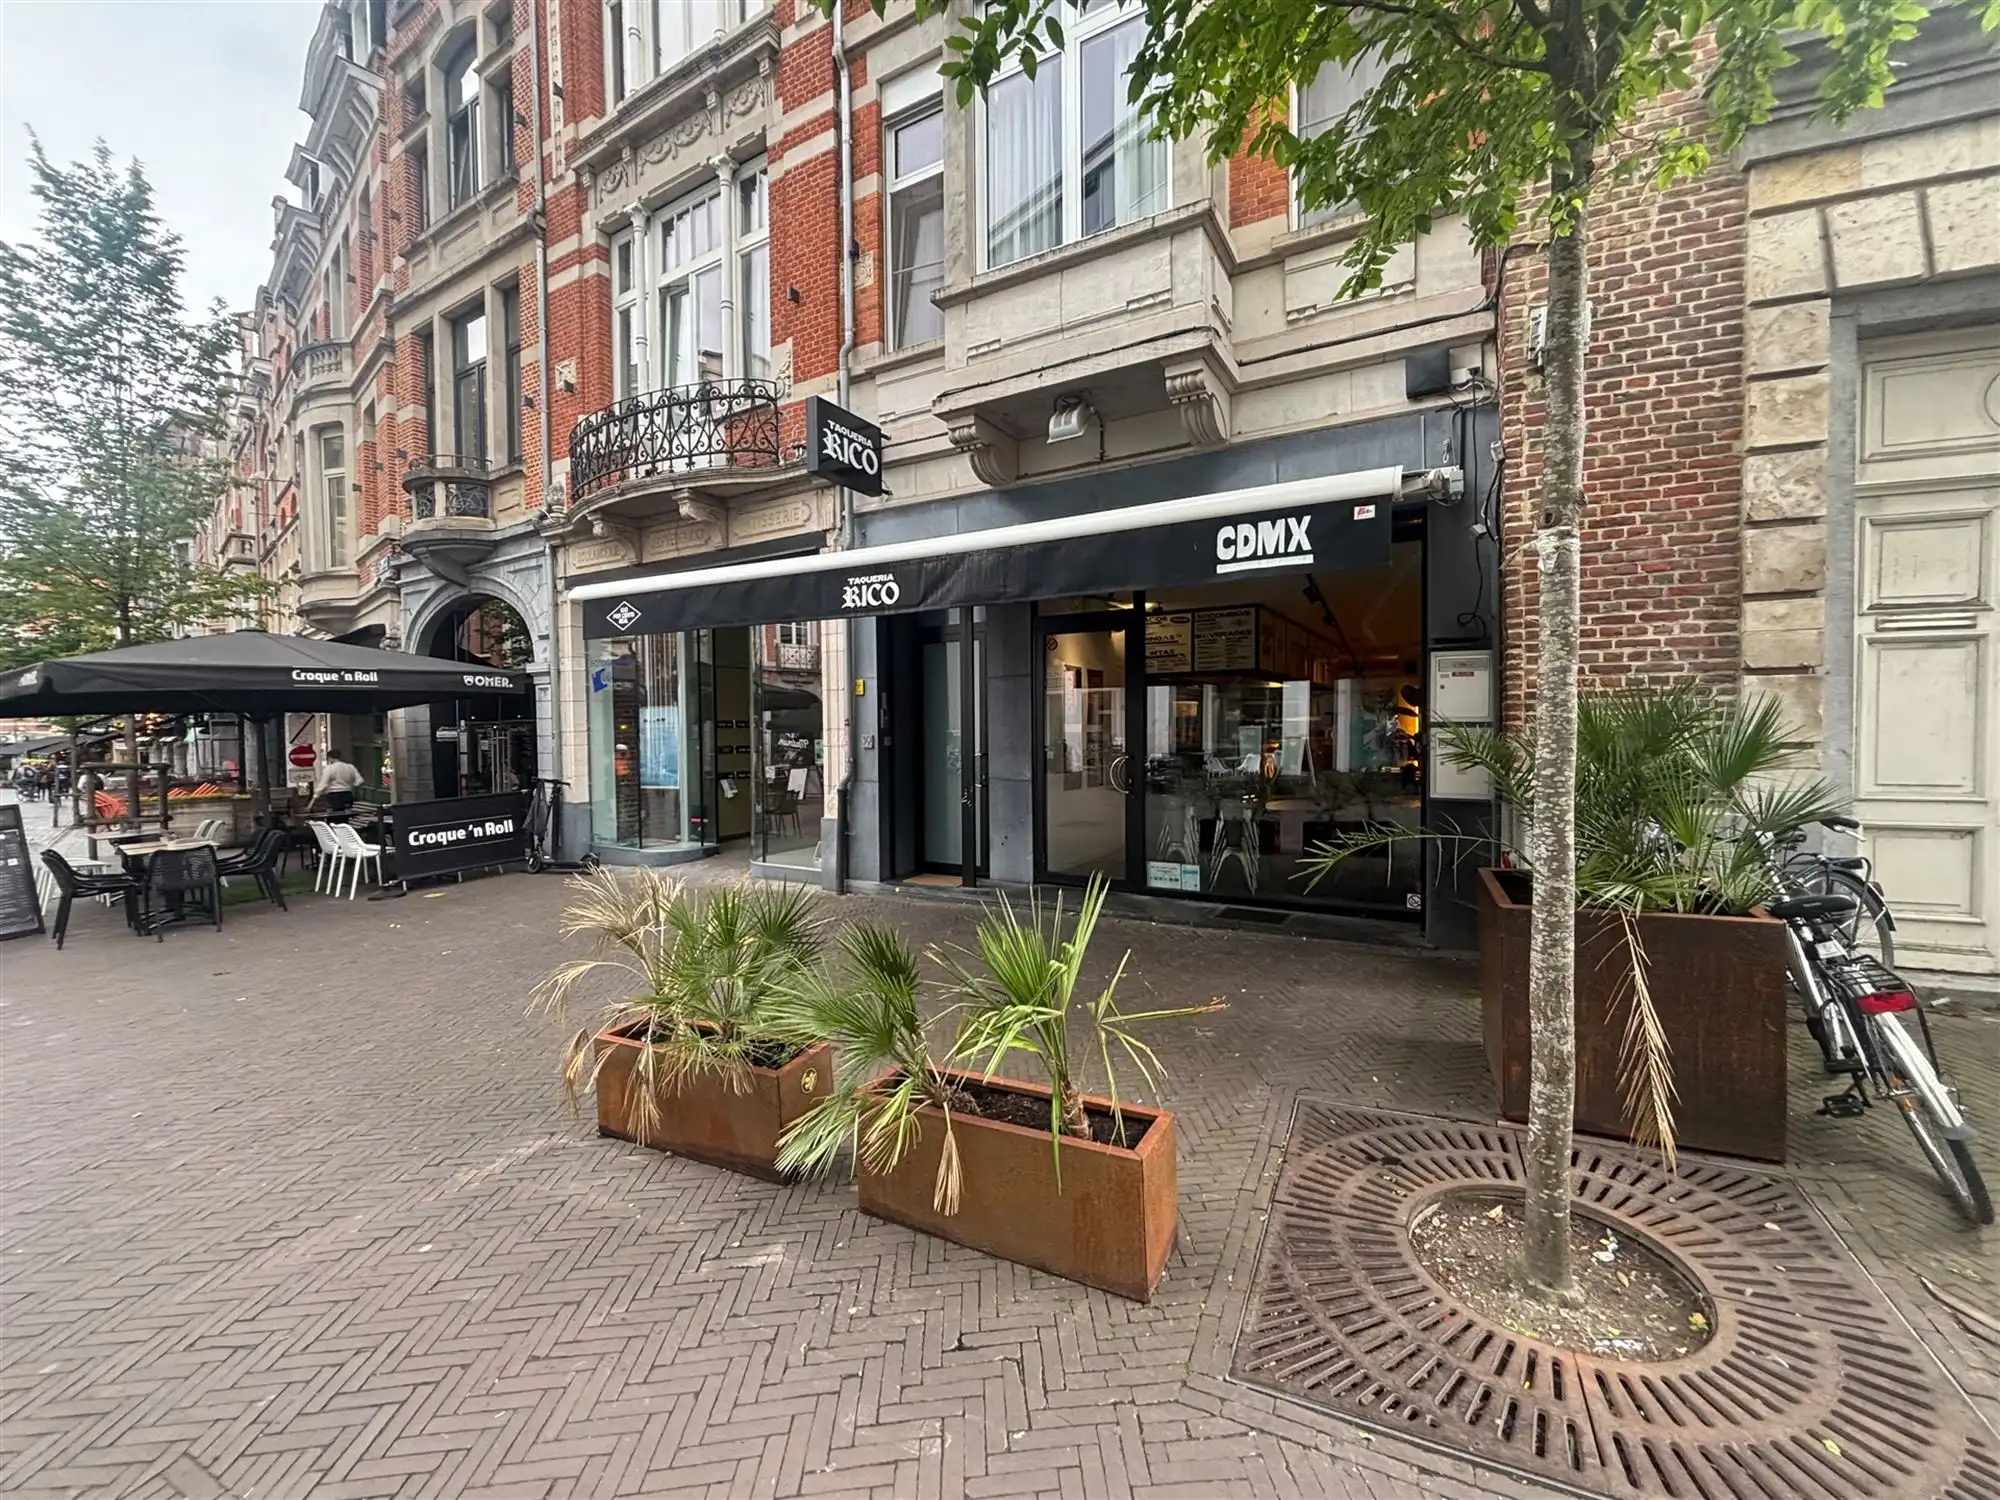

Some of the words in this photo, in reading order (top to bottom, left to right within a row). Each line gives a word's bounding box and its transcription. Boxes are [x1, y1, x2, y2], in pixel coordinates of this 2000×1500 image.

[828, 420, 873, 448] TAQUERIA
[822, 428, 878, 475] RICO
[1216, 515, 1312, 560] CDMX
[848, 573, 894, 585] TAQUERIA
[841, 581, 900, 608] RICO
[292, 670, 339, 683] Croque
[354, 671, 379, 682] Roll
[408, 828, 467, 846] Croque
[484, 819, 514, 836] Roll
